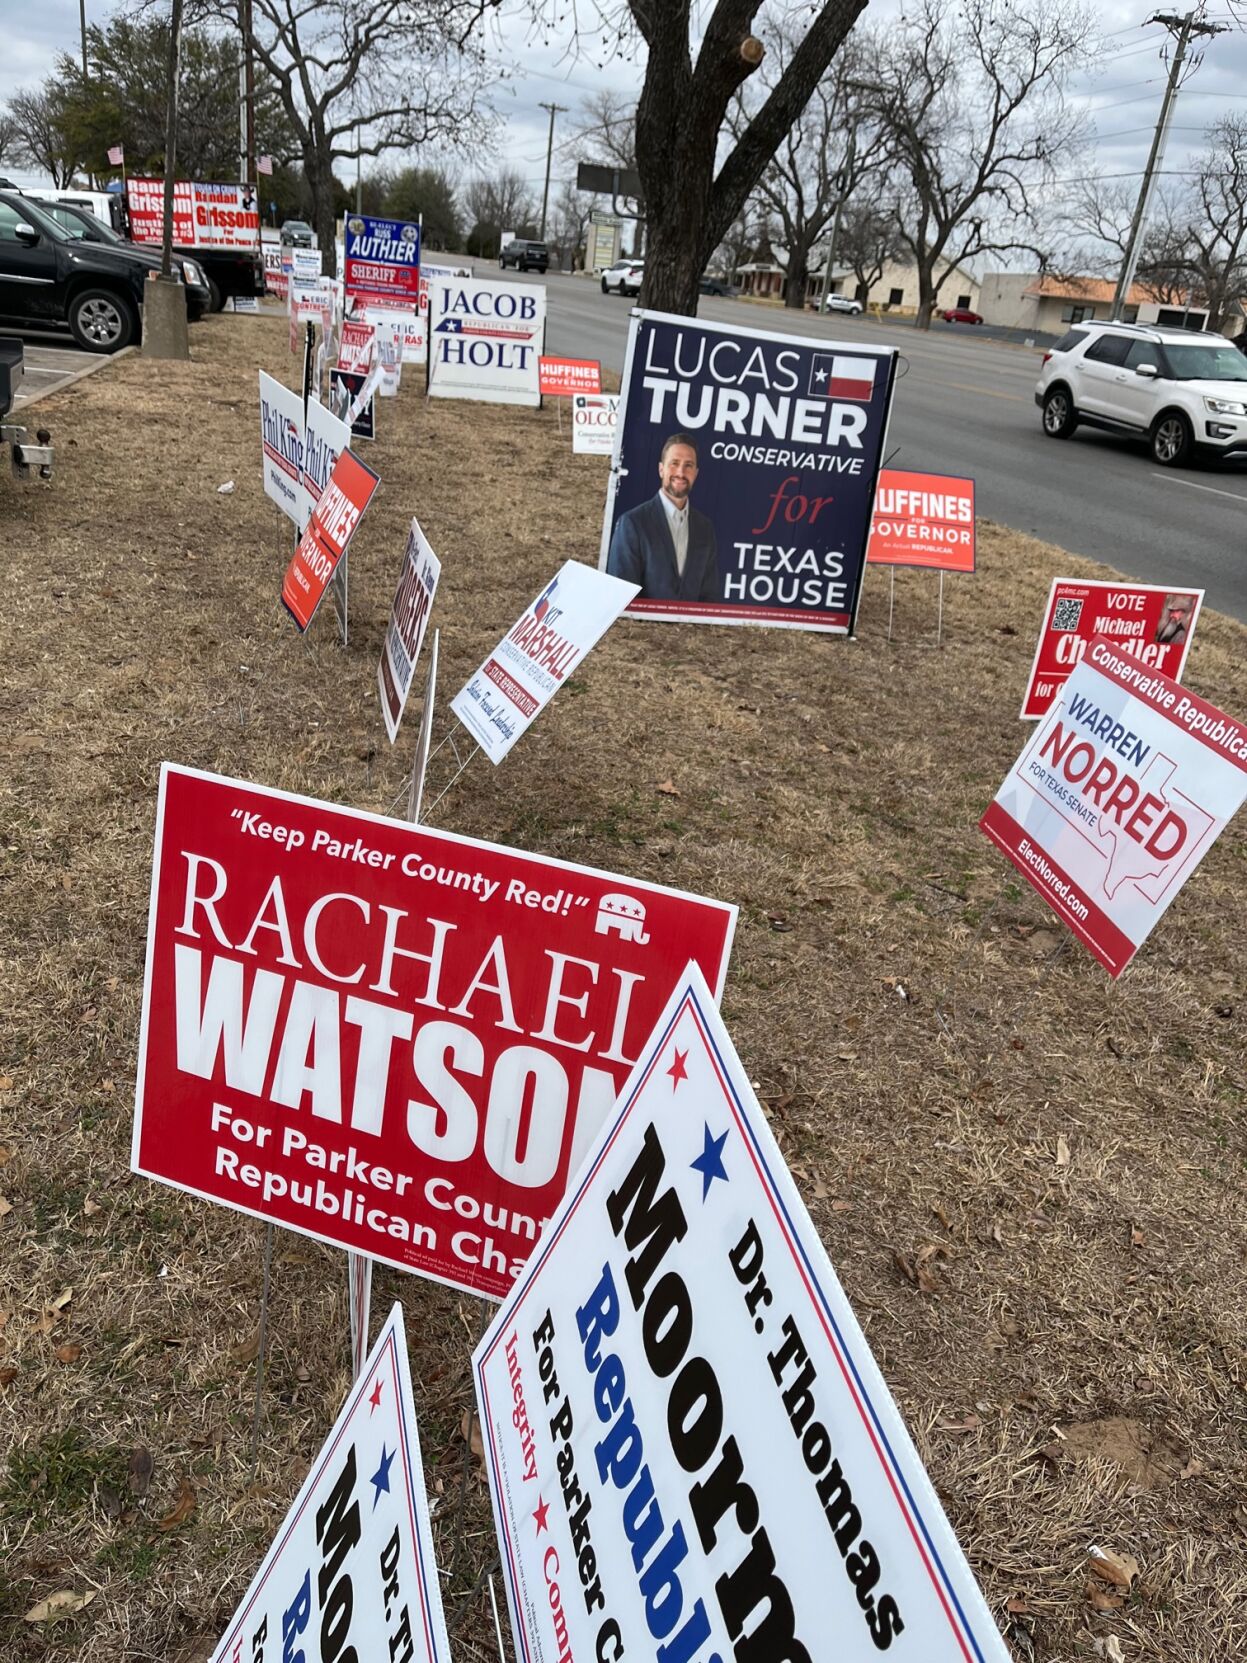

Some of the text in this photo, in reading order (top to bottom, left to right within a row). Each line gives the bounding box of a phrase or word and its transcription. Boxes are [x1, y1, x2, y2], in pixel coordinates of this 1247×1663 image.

[195, 191, 238, 204] Randall
[196, 205, 260, 229] Grissom
[350, 235, 416, 262] AUTHIER
[351, 263, 397, 282] SHERIFF
[440, 287, 536, 320] JACOB
[440, 338, 534, 370] HOLT
[540, 363, 600, 379] HUFFINES
[541, 376, 600, 388] GOVERNOR
[645, 328, 801, 392] LUCAS
[262, 400, 280, 451] Phil
[642, 376, 868, 449] TURNER
[710, 441, 865, 476] CONSERVATIVE
[752, 476, 834, 534] for
[733, 542, 844, 578] TEXAS
[543, 606, 563, 627] KIT
[724, 573, 848, 609] HOUSE
[1107, 592, 1146, 611] VOTE
[508, 614, 580, 681] MARSHALL
[1055, 633, 1171, 670] Chdler
[1093, 616, 1146, 637] Michael
[1034, 681, 1055, 697] for
[1092, 643, 1247, 763] Conservative Republica
[1068, 692, 1151, 767] WARREN
[1028, 761, 1098, 828] FOR TEXAS SENATE
[1038, 721, 1188, 862] NORRED
[311, 829, 396, 871] Parker
[400, 852, 501, 901] County
[1017, 838, 1090, 922] ElectNorred.com
[174, 850, 646, 1068] RACHAEL
[211, 1101, 551, 1241] For Parker Count
[213, 1145, 528, 1280] Republican Cha
[504, 1329, 539, 1484] Integrity
[606, 1121, 814, 1663] Moorm
[532, 1308, 605, 1616] For Parker
[575, 1261, 715, 1663] Republ
[727, 1217, 905, 1652] Dr. Thomas
[379, 1523, 401, 1623] Dr.
